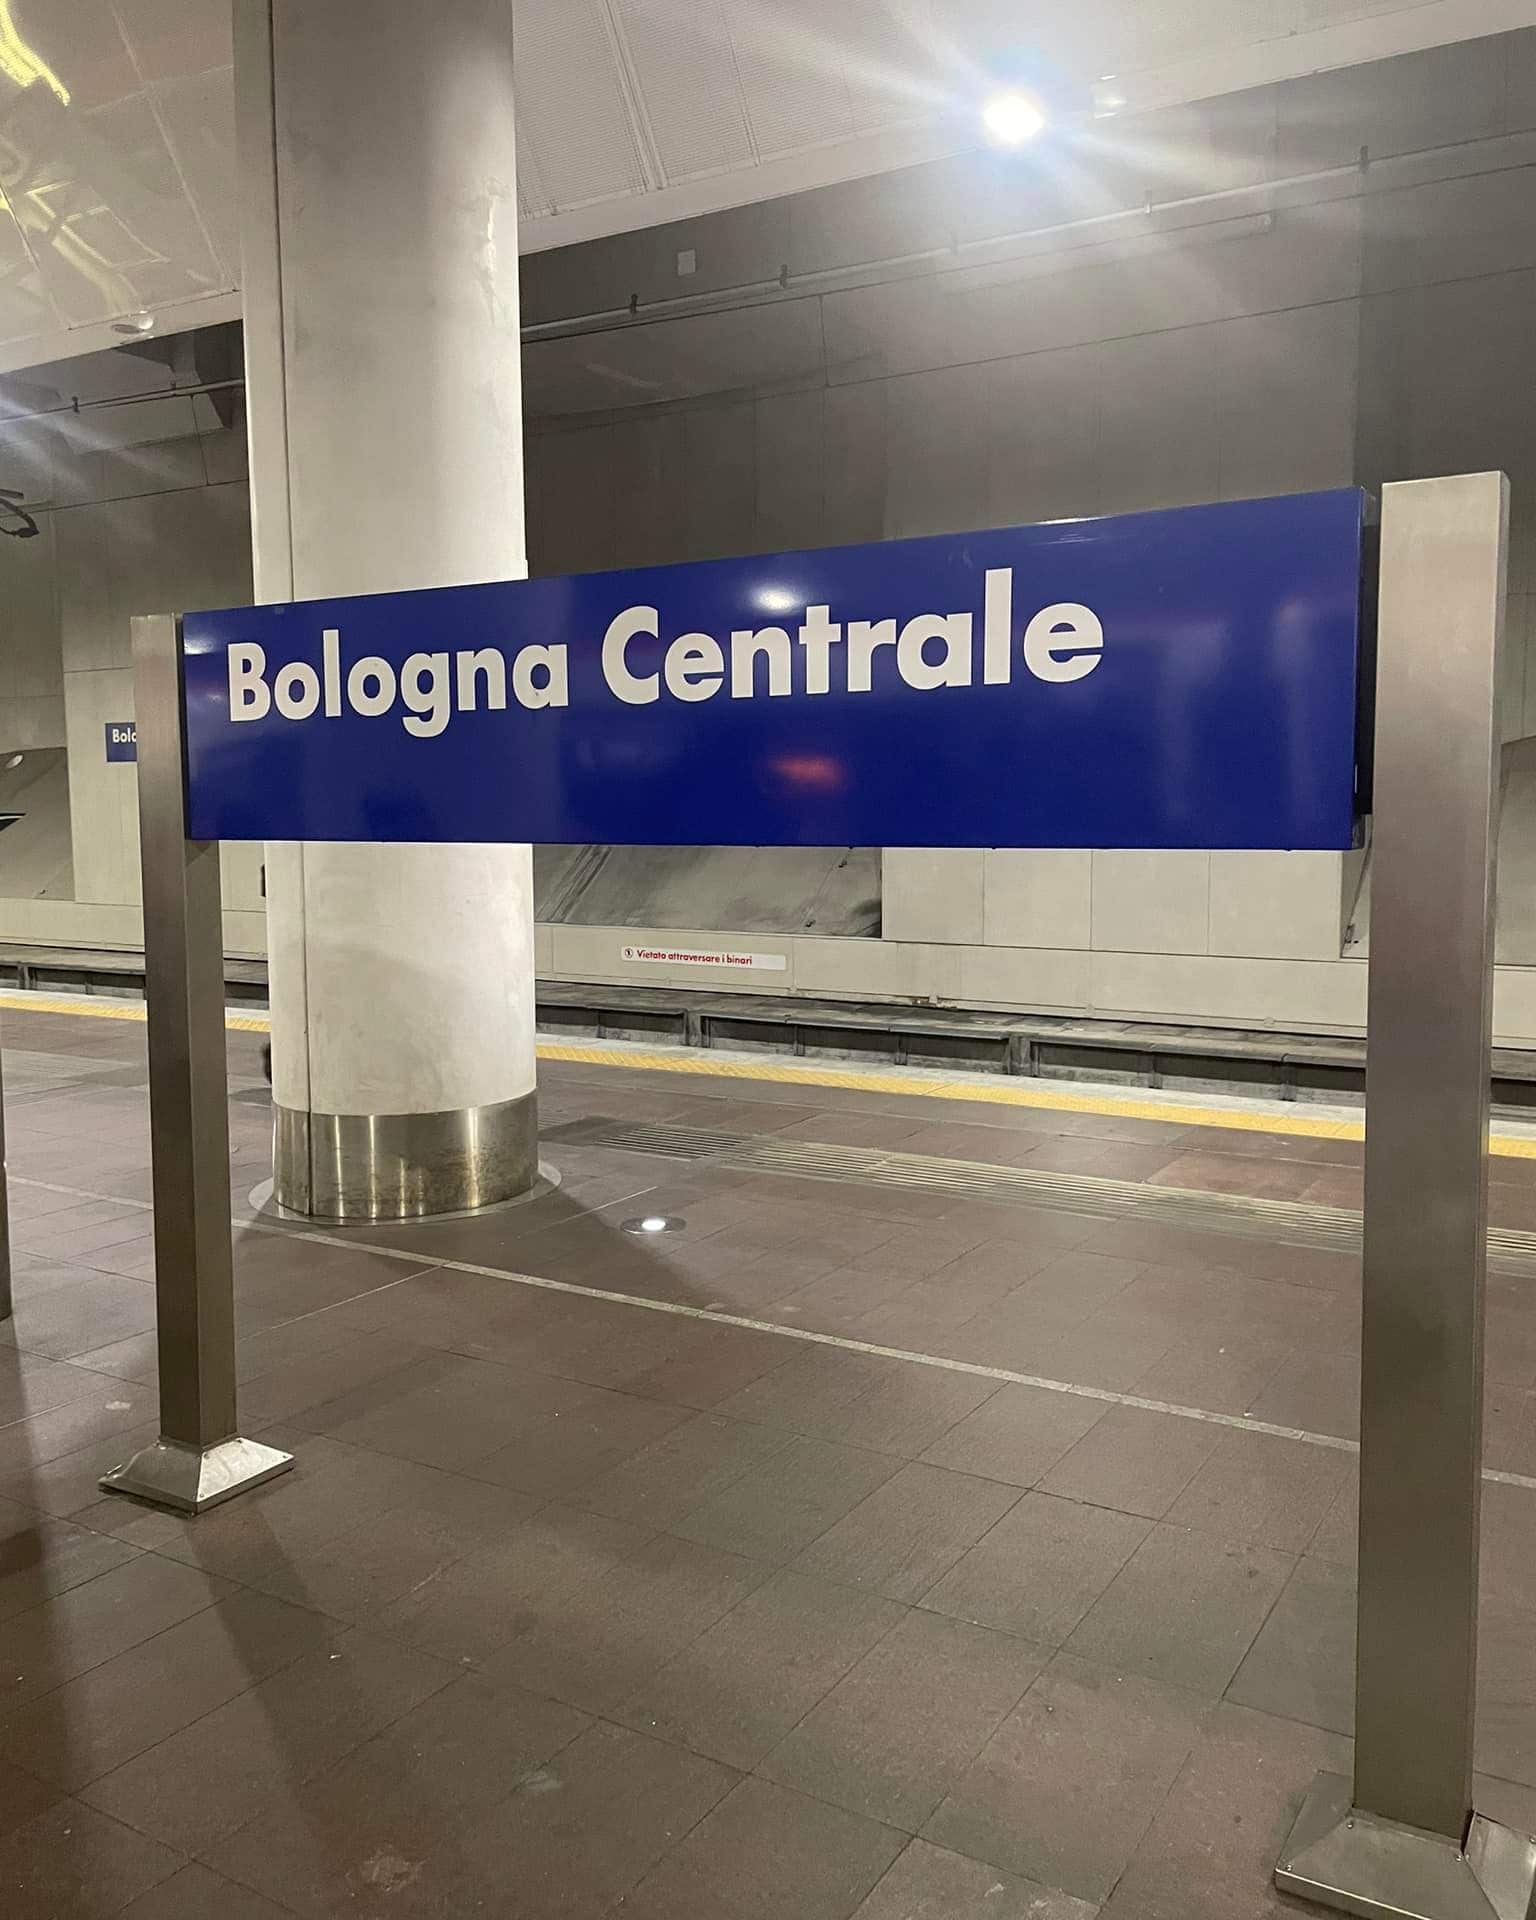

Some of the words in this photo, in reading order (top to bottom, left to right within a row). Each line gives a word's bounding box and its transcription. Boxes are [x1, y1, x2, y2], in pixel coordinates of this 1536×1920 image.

[228, 629, 569, 738] Bologna
[601, 567, 1104, 706] Centrale
[637, 949, 666, 960] Vietato
[668, 951, 720, 963] attraversare
[726, 955, 752, 965] binari
